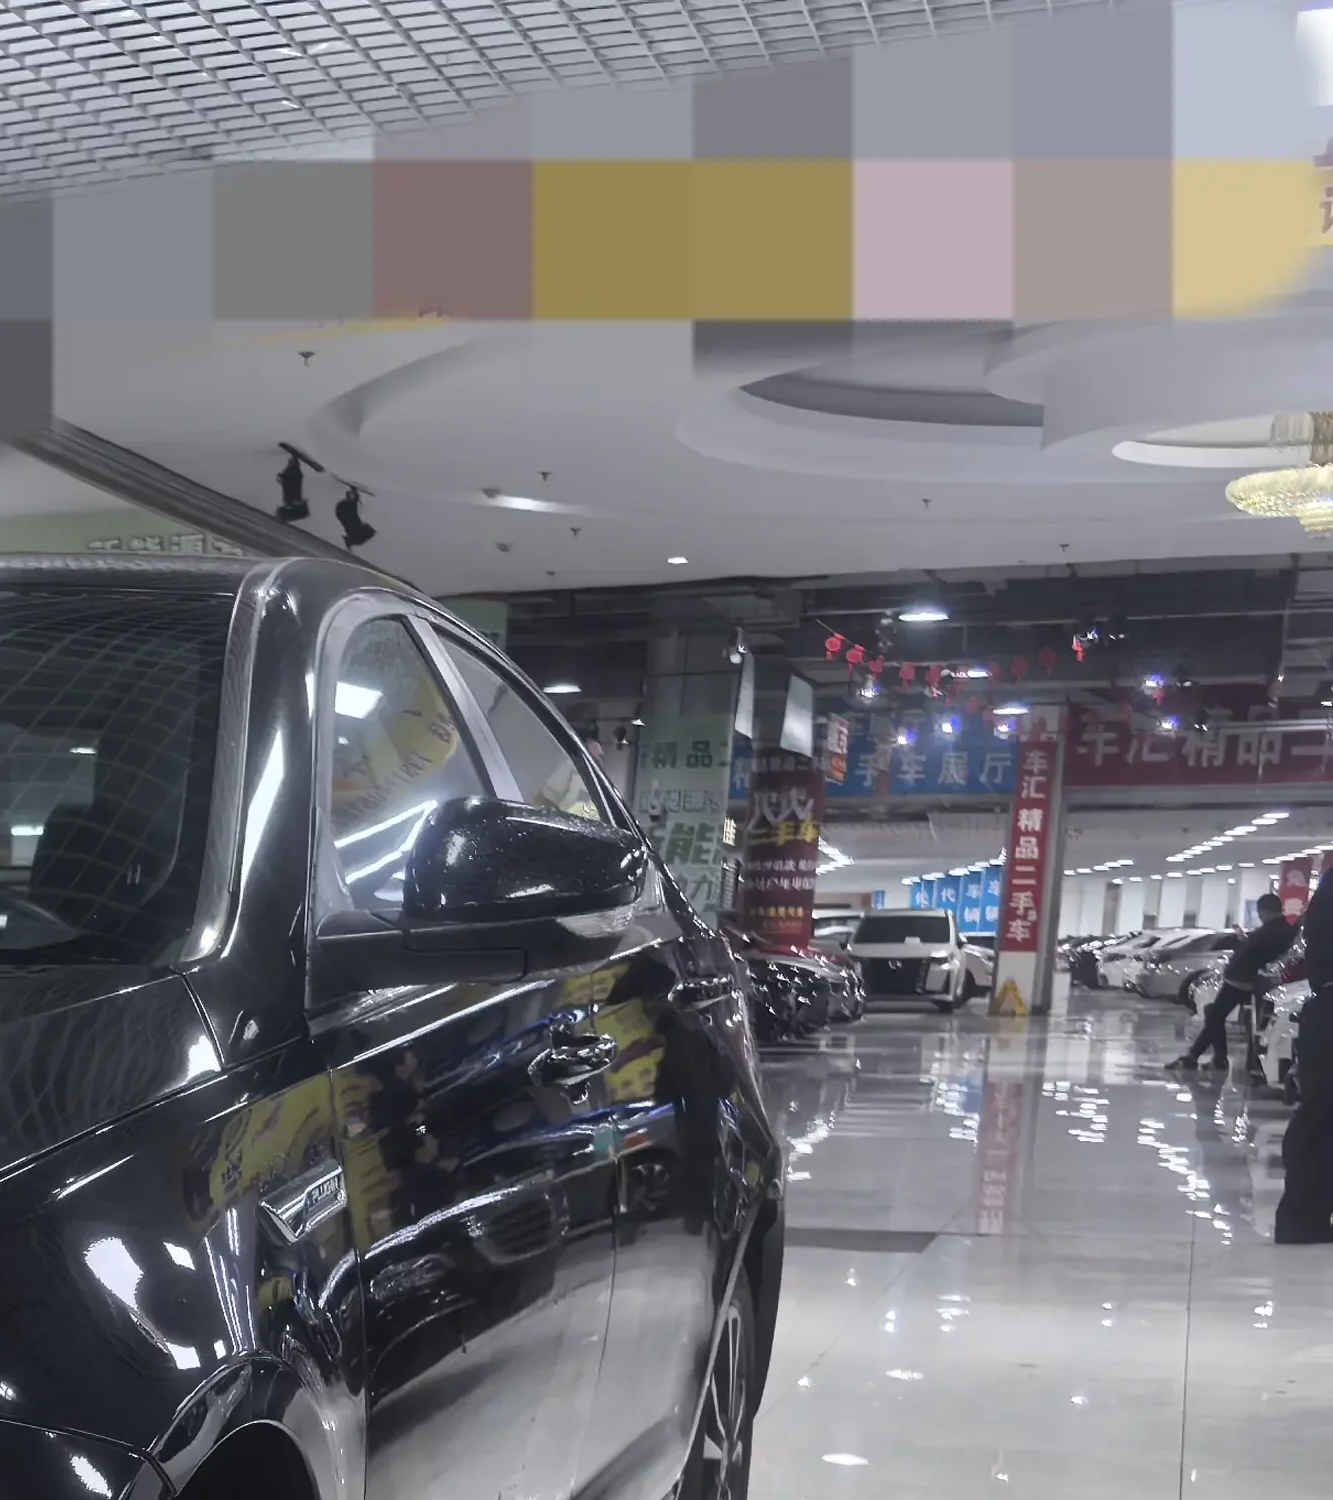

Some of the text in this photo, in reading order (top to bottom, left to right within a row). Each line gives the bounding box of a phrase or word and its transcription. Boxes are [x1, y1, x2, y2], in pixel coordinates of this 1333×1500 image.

[1006, 751, 1050, 943] 车汇精品二手车
